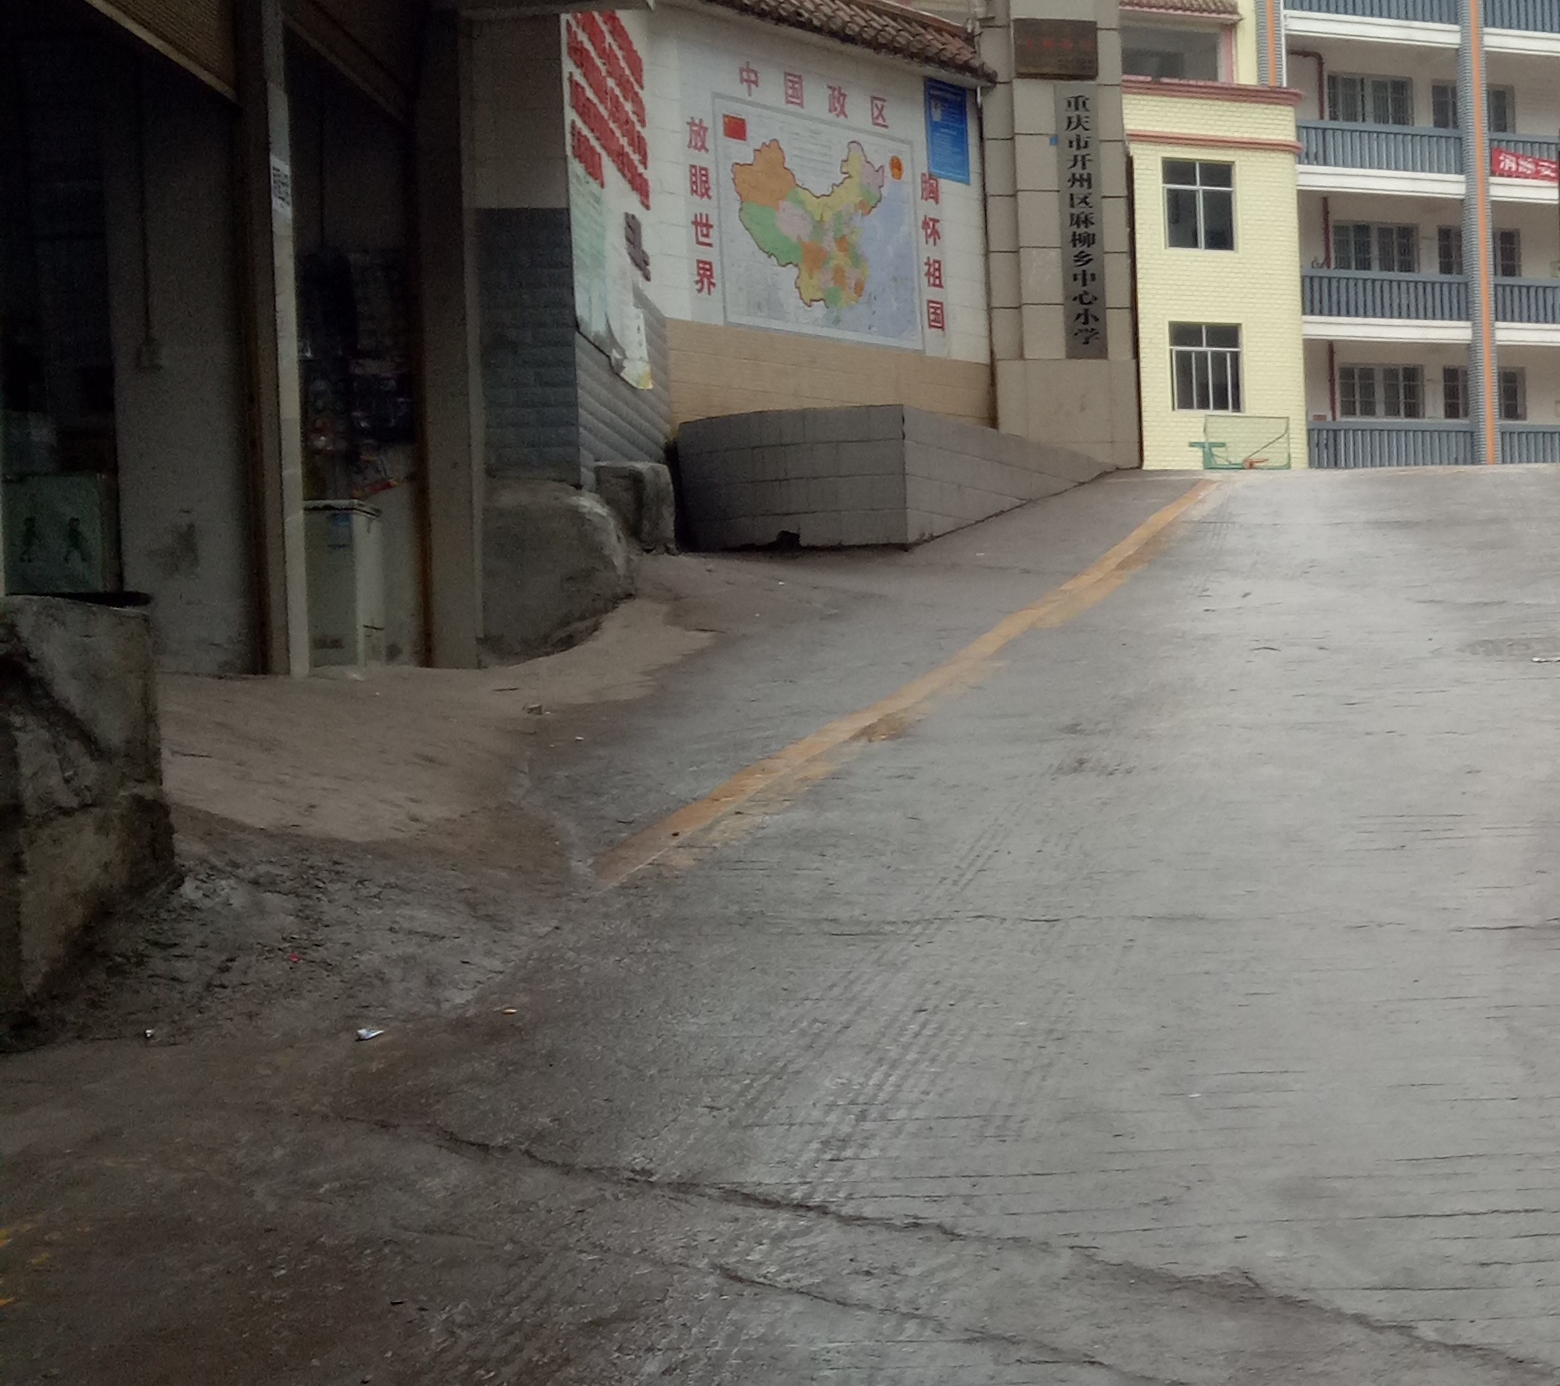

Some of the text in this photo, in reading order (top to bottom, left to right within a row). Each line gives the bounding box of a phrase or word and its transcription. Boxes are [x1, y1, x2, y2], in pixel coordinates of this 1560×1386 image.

[738, 59, 890, 131] 中国政区
[686, 115, 718, 296] 放眼世界
[920, 172, 946, 332] 胸怀祖国
[1064, 94, 1101, 345] 重庆市开州区麻柳乡中心小学
